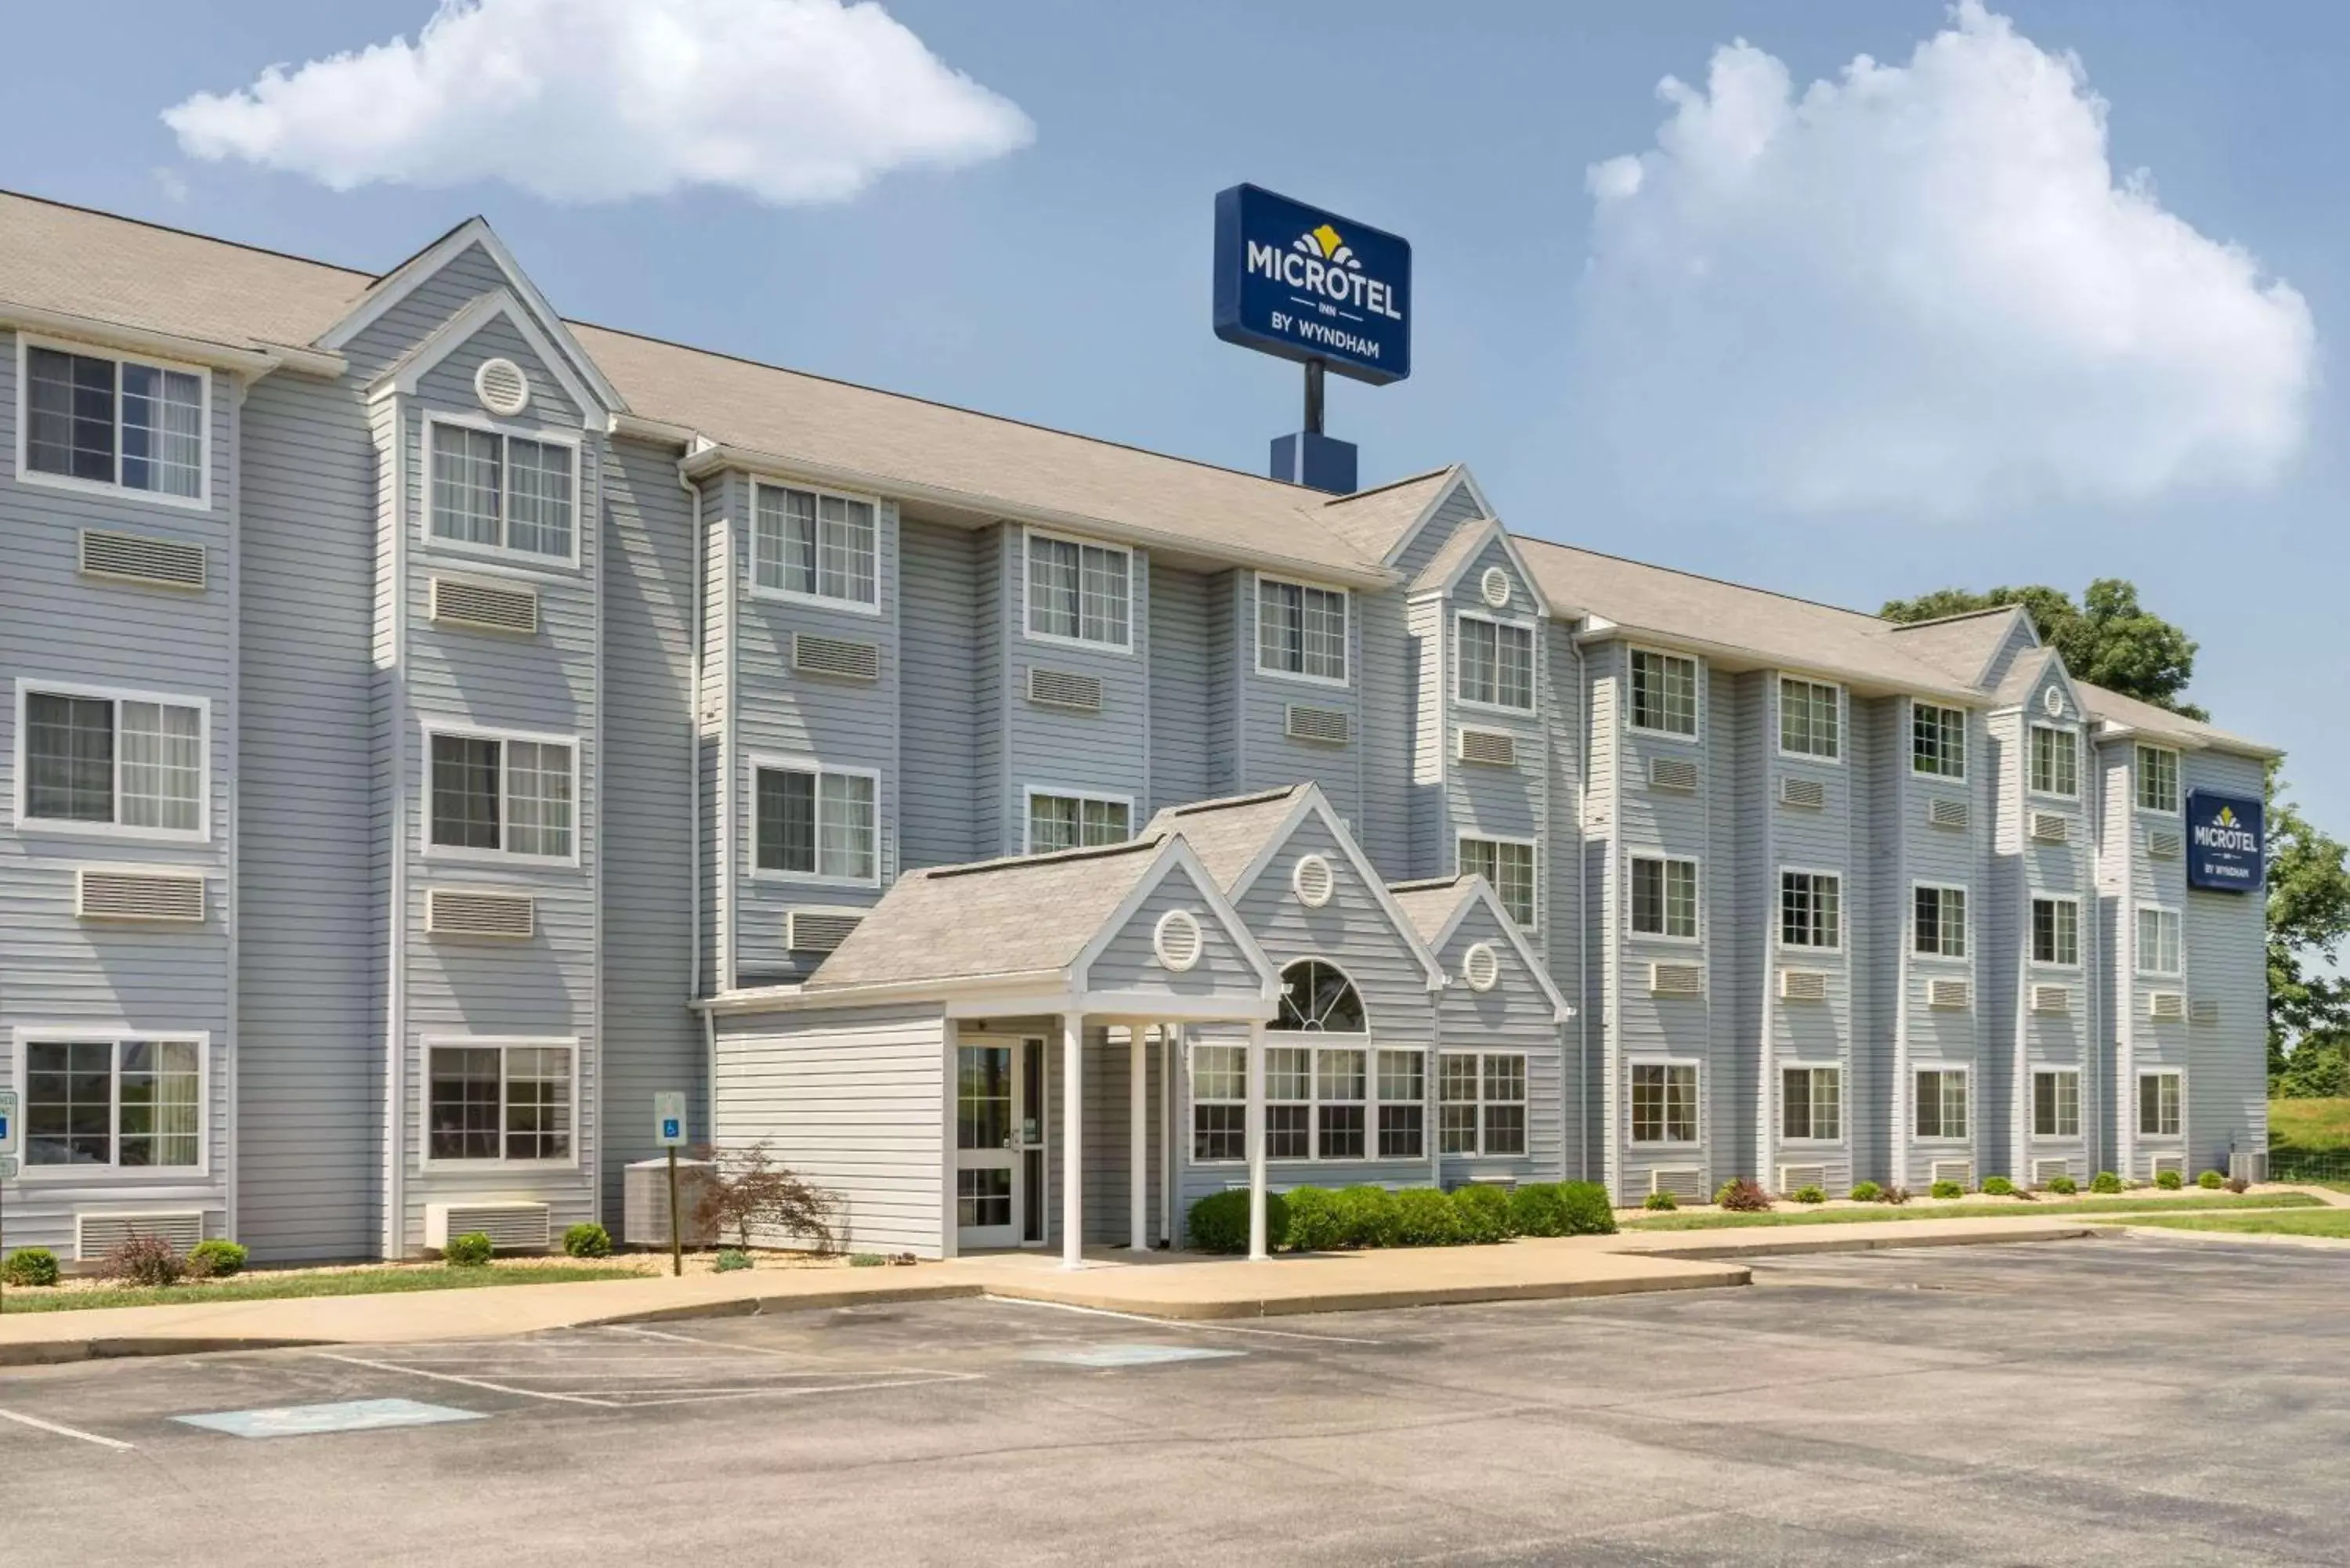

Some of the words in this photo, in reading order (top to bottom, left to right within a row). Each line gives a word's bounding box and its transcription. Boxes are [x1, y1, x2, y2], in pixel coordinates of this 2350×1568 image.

[1248, 240, 1401, 320] MICROTEL
[1318, 302, 1336, 317] INN
[1271, 311, 1292, 332] BY
[1299, 318, 1379, 359] WYNDHAM
[2194, 825, 2258, 853] MICROTEL
[2204, 863, 2214, 875] BY
